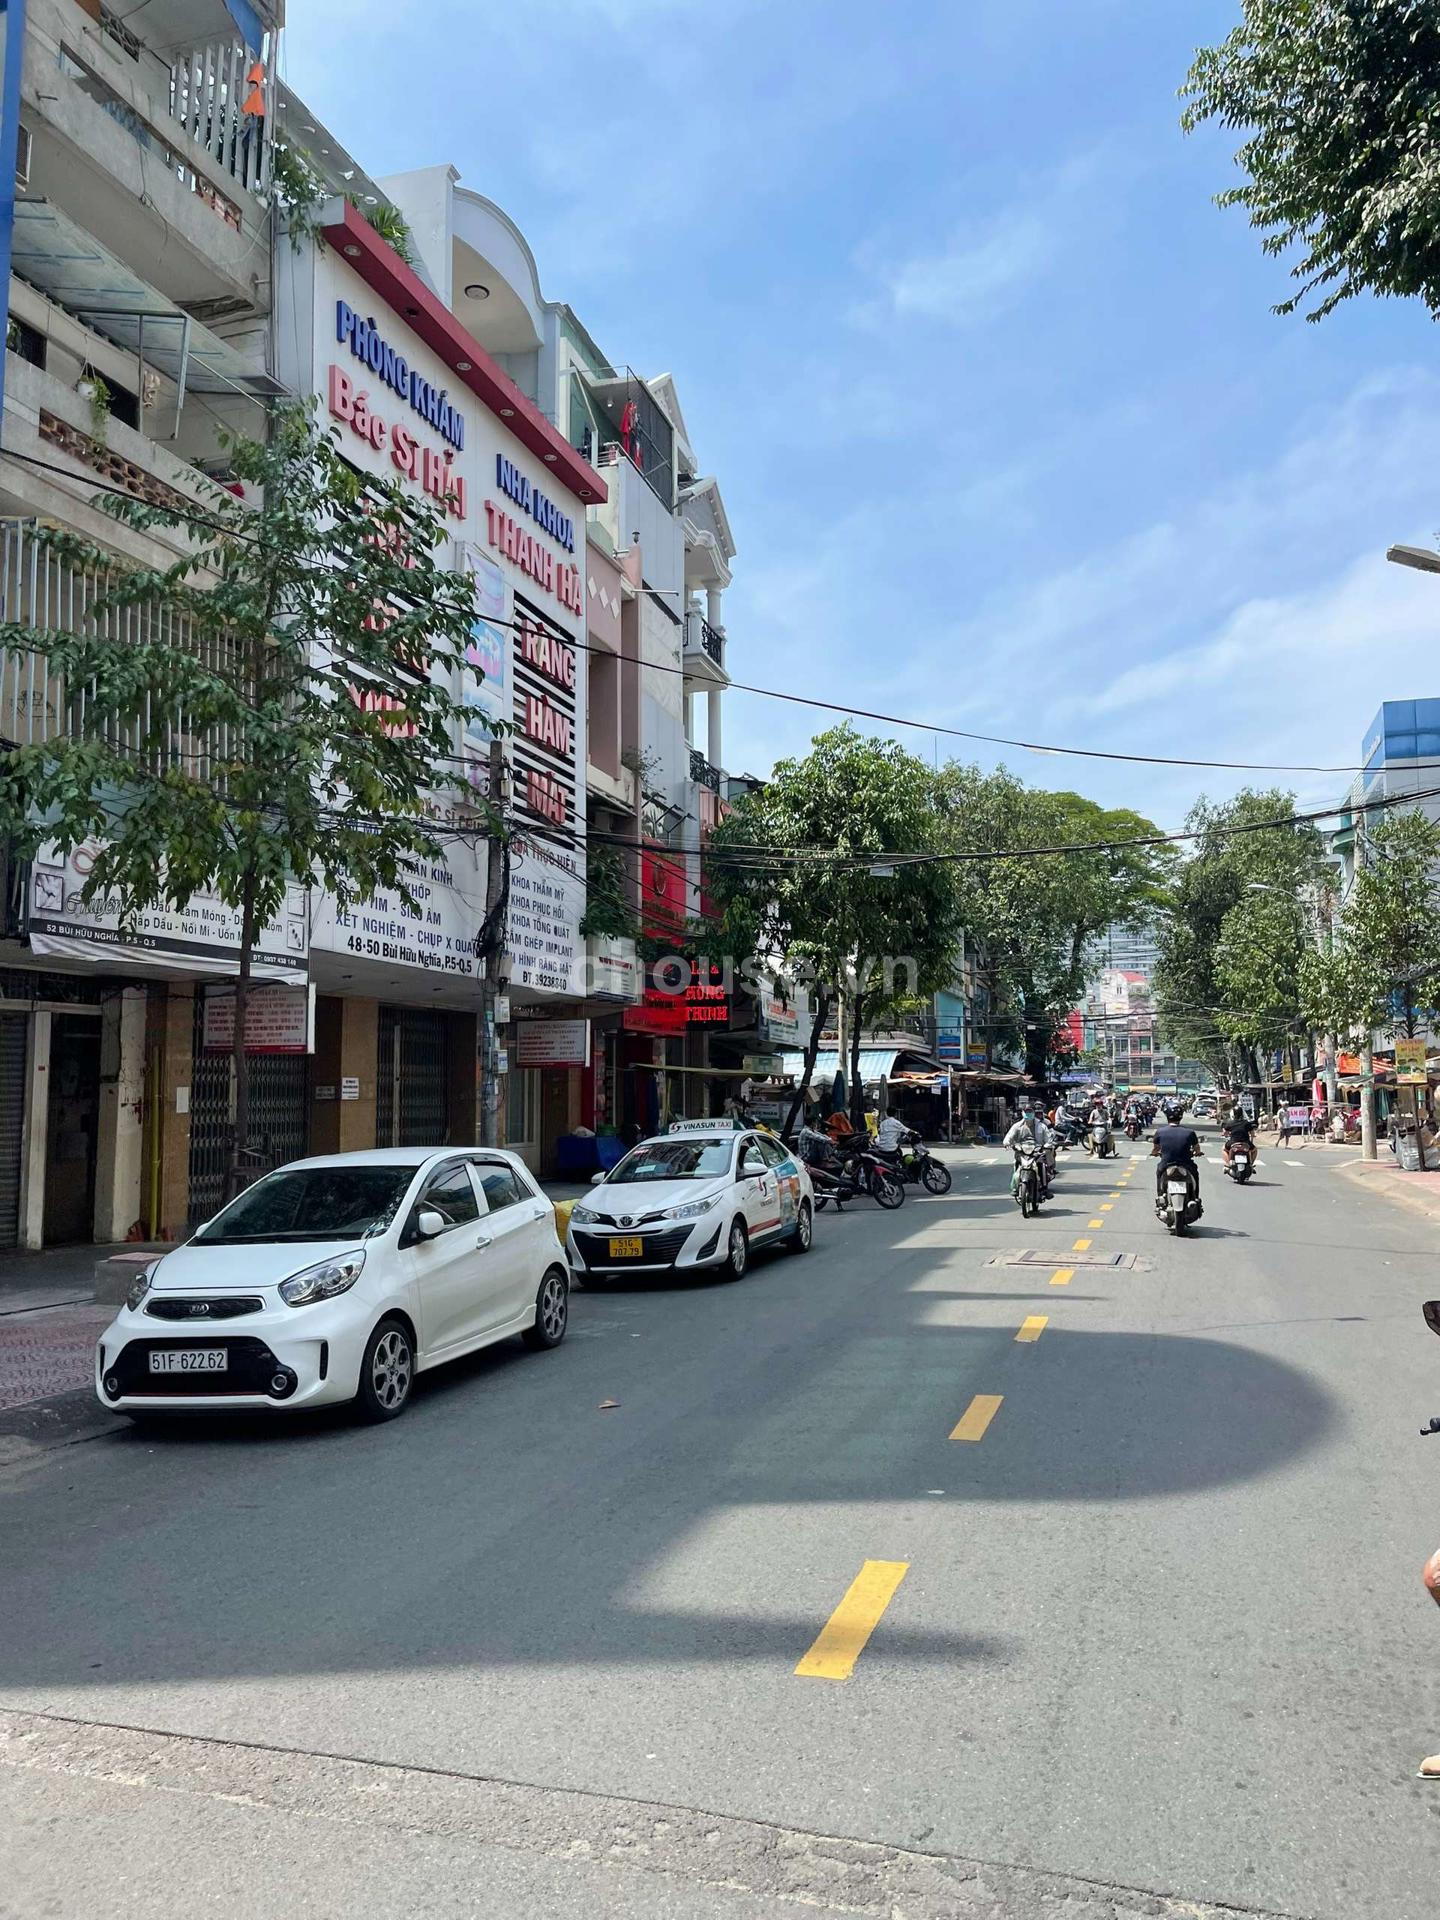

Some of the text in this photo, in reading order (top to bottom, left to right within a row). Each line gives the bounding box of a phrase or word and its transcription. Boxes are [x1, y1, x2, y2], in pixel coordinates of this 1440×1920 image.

[336, 300, 465, 451] PHÒNG KHÁM
[329, 364, 386, 450] Bác
[423, 447, 467, 520] HẢI
[496, 453, 575, 553] NHA KHOA
[484, 500, 553, 592] THANH
[557, 563, 583, 616] HÀ
[525, 695, 570, 755] HÀM
[431, 866, 453, 885] KINH
[511, 874, 530, 891] KHOA
[511, 894, 530, 910] KHOA
[46, 924, 56, 932] 52
[511, 913, 530, 929] KHOA
[200, 925, 210, 937] Mi
[363, 916, 406, 940] NGHIỆM
[417, 930, 443, 949] CHỤP
[446, 936, 452, 950] X
[383, 944, 398, 959] Bùi
[399, 945, 417, 964] Hữu
[518, 950, 536, 968] HÌNH
[546, 942, 573, 959] IMPLANT
[683, 1121, 716, 1130] VINASUN
[618, 1239, 634, 1247] 51G
[152, 1352, 225, 1370] 51F-622.62
